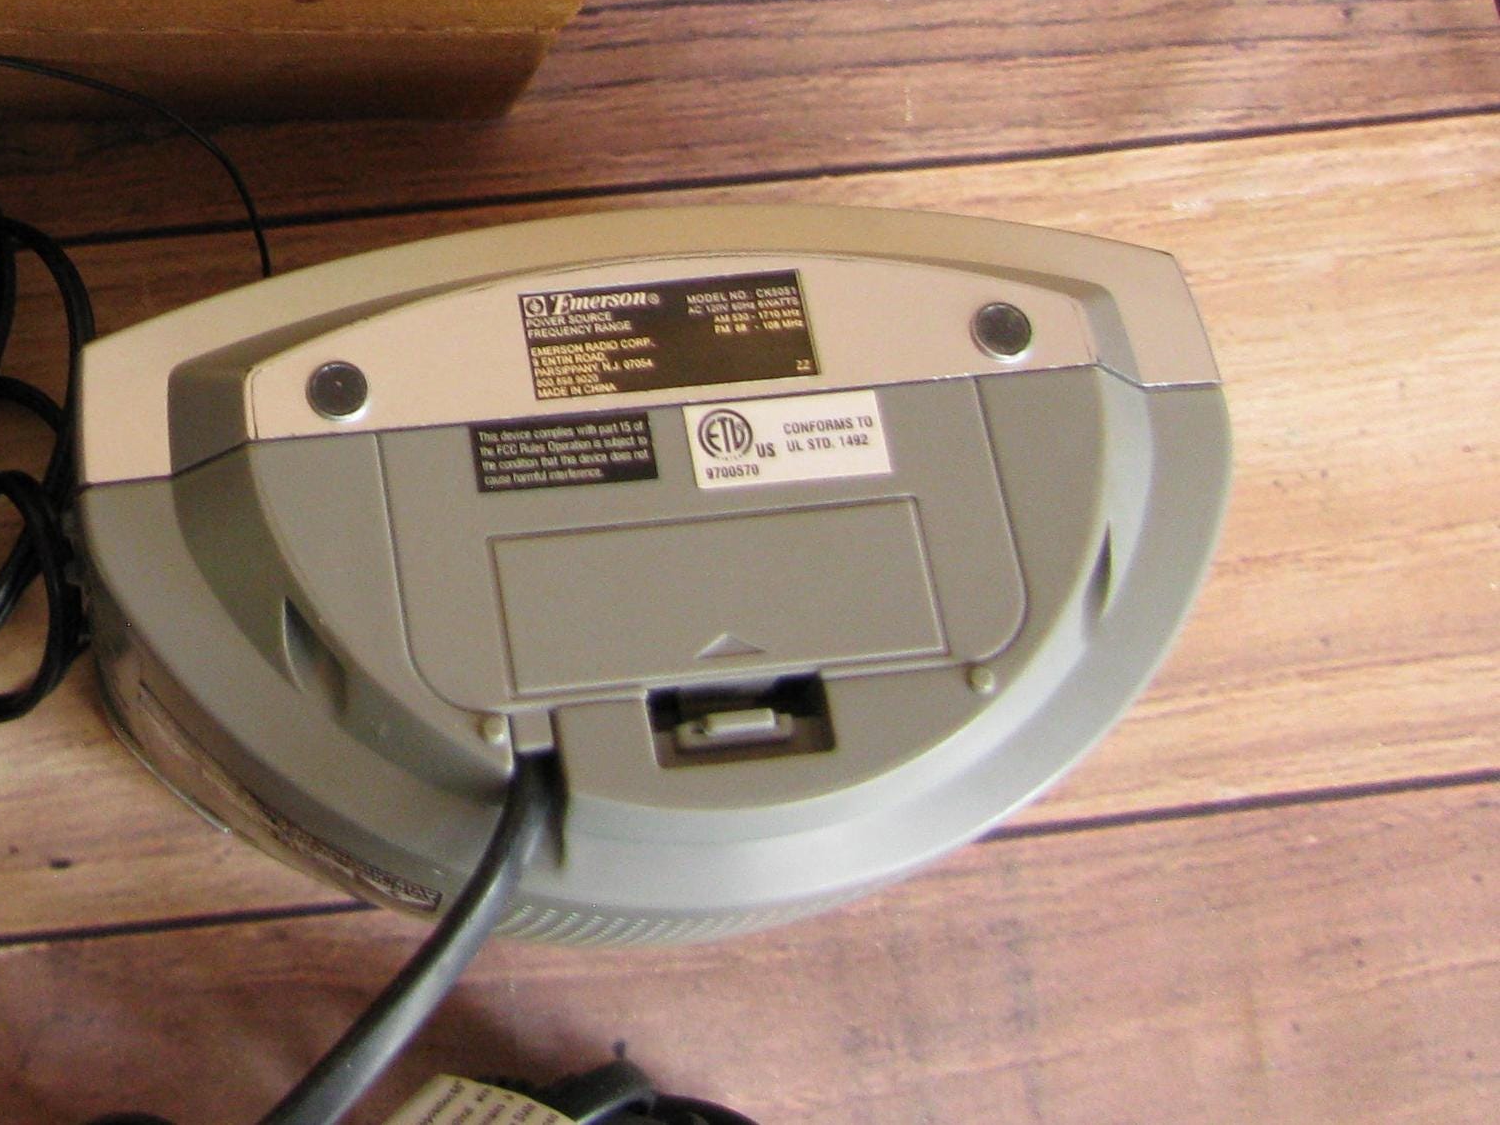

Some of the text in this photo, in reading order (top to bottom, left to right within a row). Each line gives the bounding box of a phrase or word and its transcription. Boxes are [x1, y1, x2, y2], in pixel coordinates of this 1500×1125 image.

[550, 292, 647, 315] Emerson
[686, 292, 727, 304] MODEL
[526, 311, 612, 327] POWER SOURCE
[527, 320, 632, 339] FREQUENCY RANGE
[531, 340, 618, 356] EMERSON RADIO
[541, 355, 573, 365] ENTIN
[537, 386, 568, 397] MADE
[583, 382, 617, 394] CHINA
[599, 423, 617, 435] part
[783, 416, 873, 435] CONFORMS TO
[497, 444, 518, 455] FCC
[755, 442, 776, 458] US
[786, 439, 804, 452] UL
[839, 434, 869, 448] 1492
